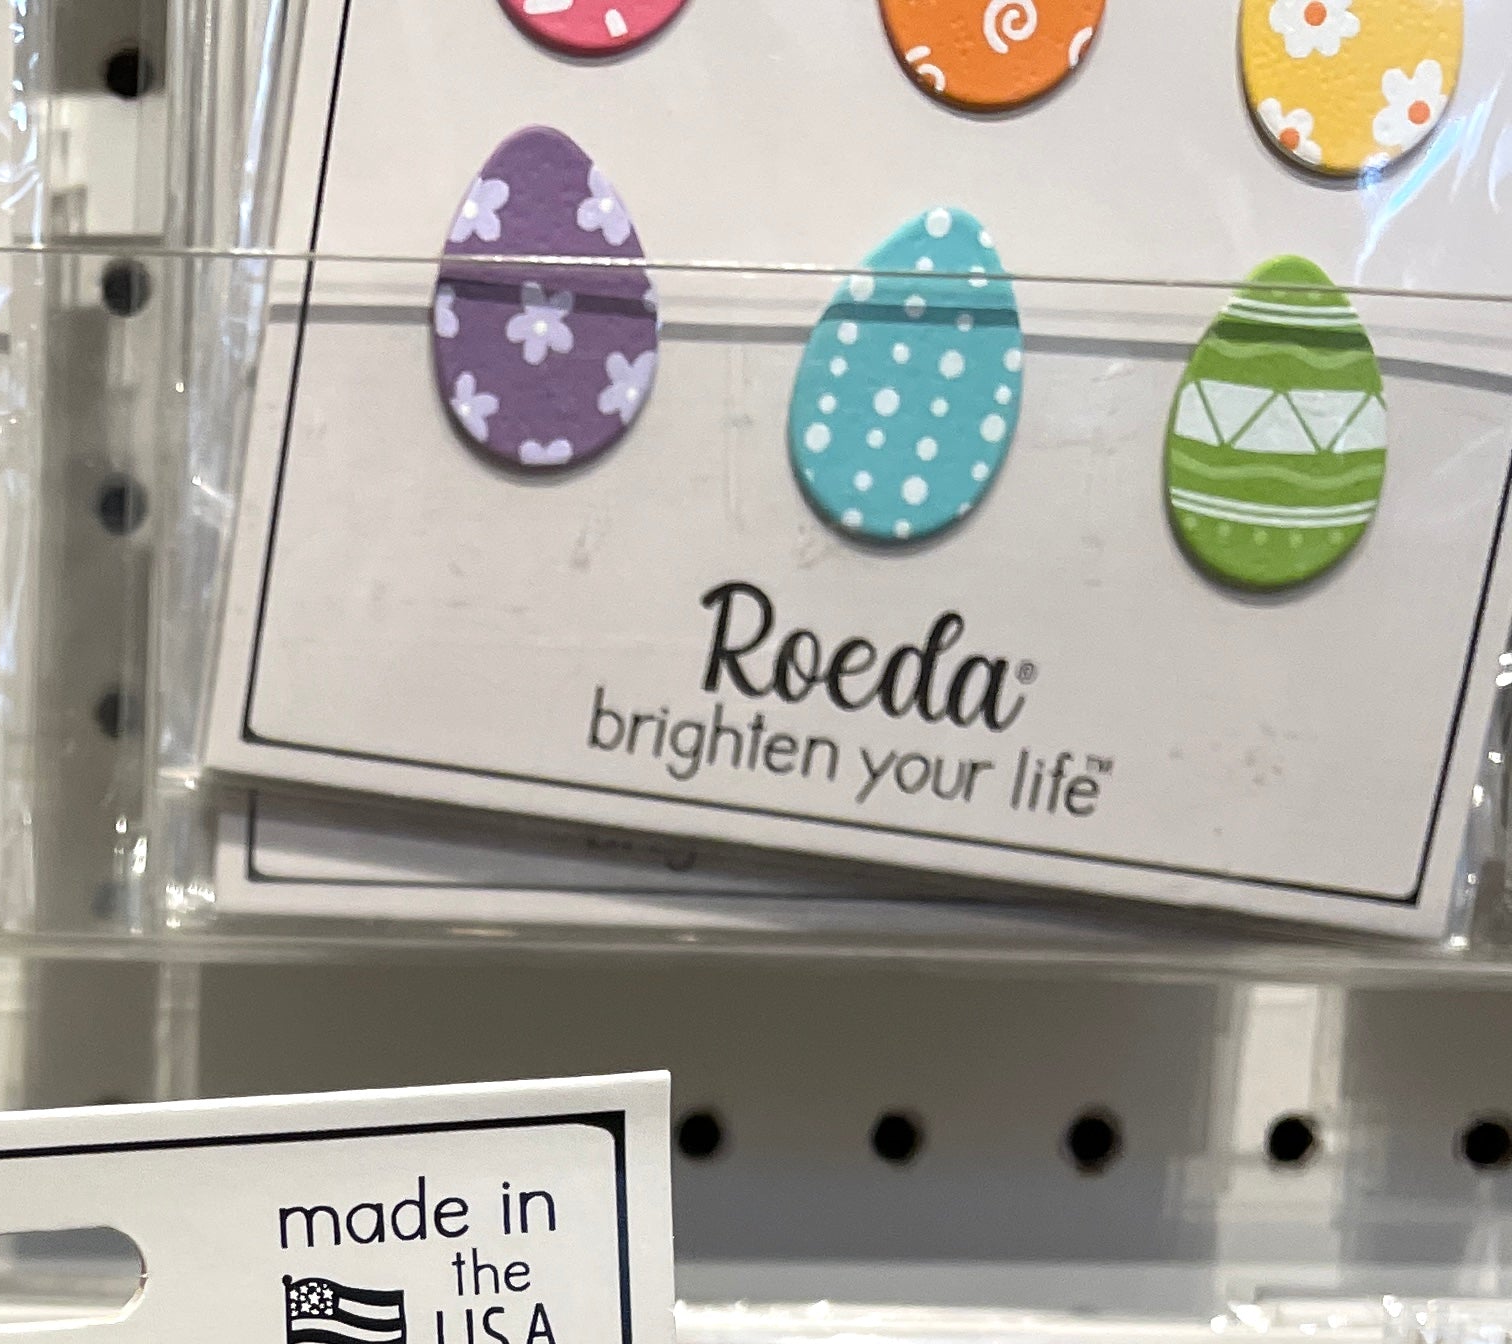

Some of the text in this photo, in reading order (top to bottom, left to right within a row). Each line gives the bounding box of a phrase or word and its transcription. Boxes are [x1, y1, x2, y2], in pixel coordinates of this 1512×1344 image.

[587, 687, 840, 782] brighten
[855, 745, 995, 803] your
[279, 1175, 556, 1249] made in
[451, 1247, 531, 1296] the
